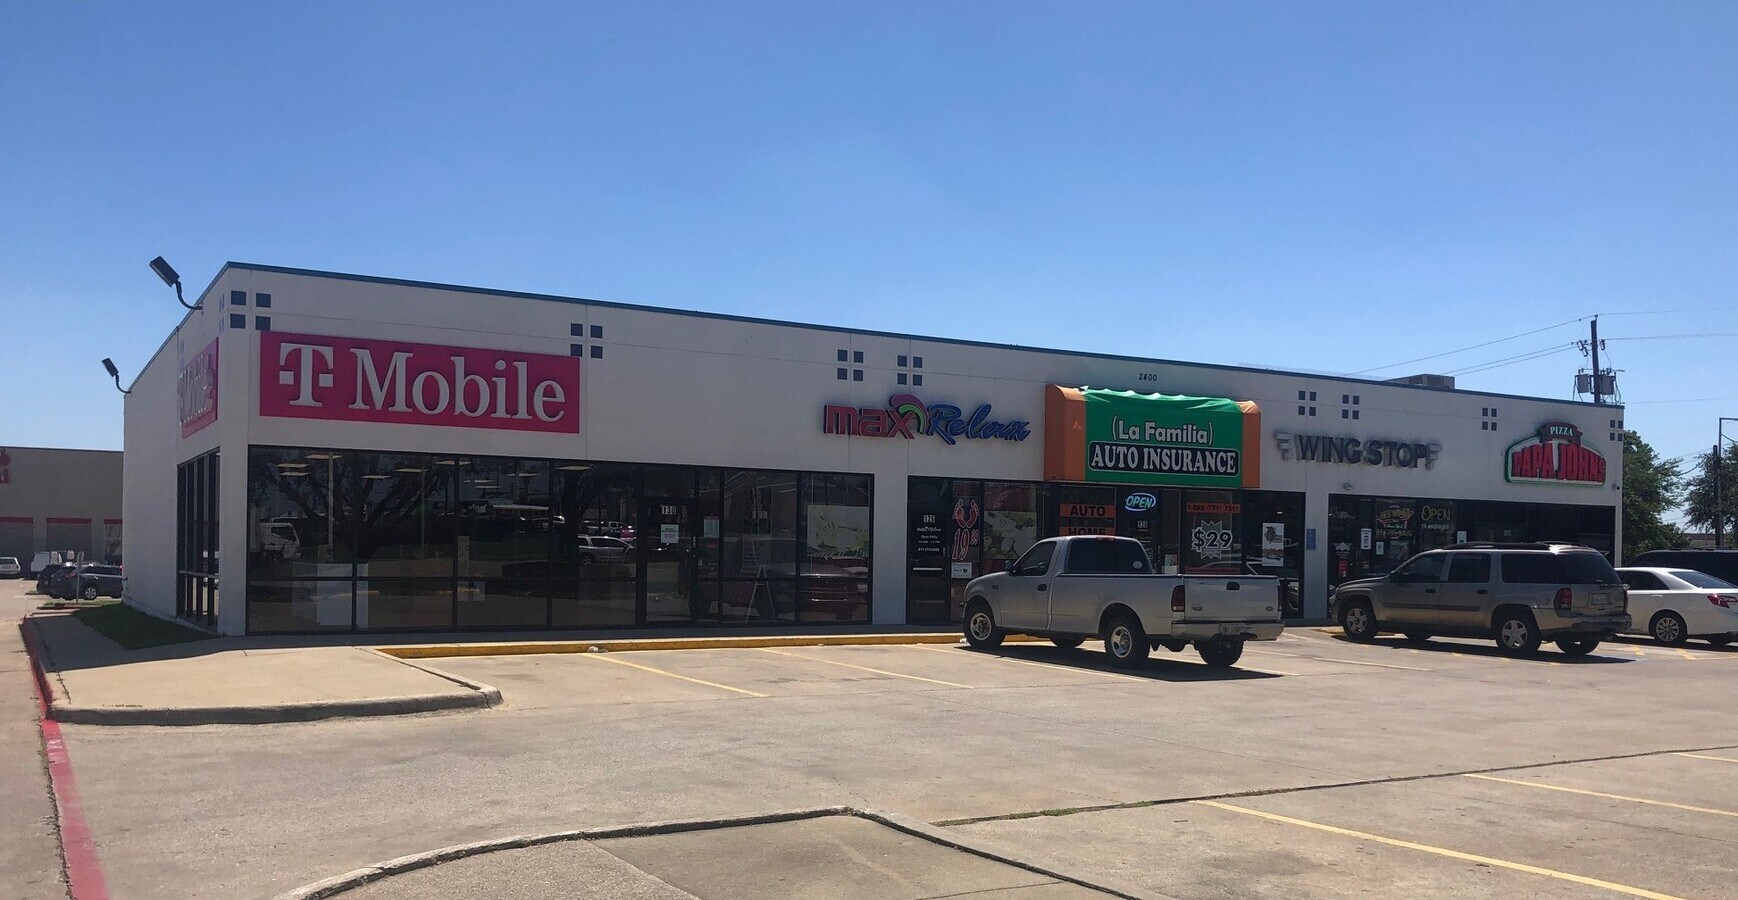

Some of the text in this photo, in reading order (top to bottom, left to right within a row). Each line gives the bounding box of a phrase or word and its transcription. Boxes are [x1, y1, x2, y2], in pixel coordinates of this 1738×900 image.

[348, 347, 566, 422] Mobile
[1138, 373, 1158, 382] 2400
[926, 403, 1032, 446] Relax
[1550, 425, 1574, 437] PIZZA
[1091, 444, 1236, 473] AUTO INSURANCE
[1511, 442, 1555, 479] PAPA
[1069, 505, 1106, 517] AUTO
[1125, 495, 1154, 509] OPEN
[1192, 528, 1233, 552] $29
